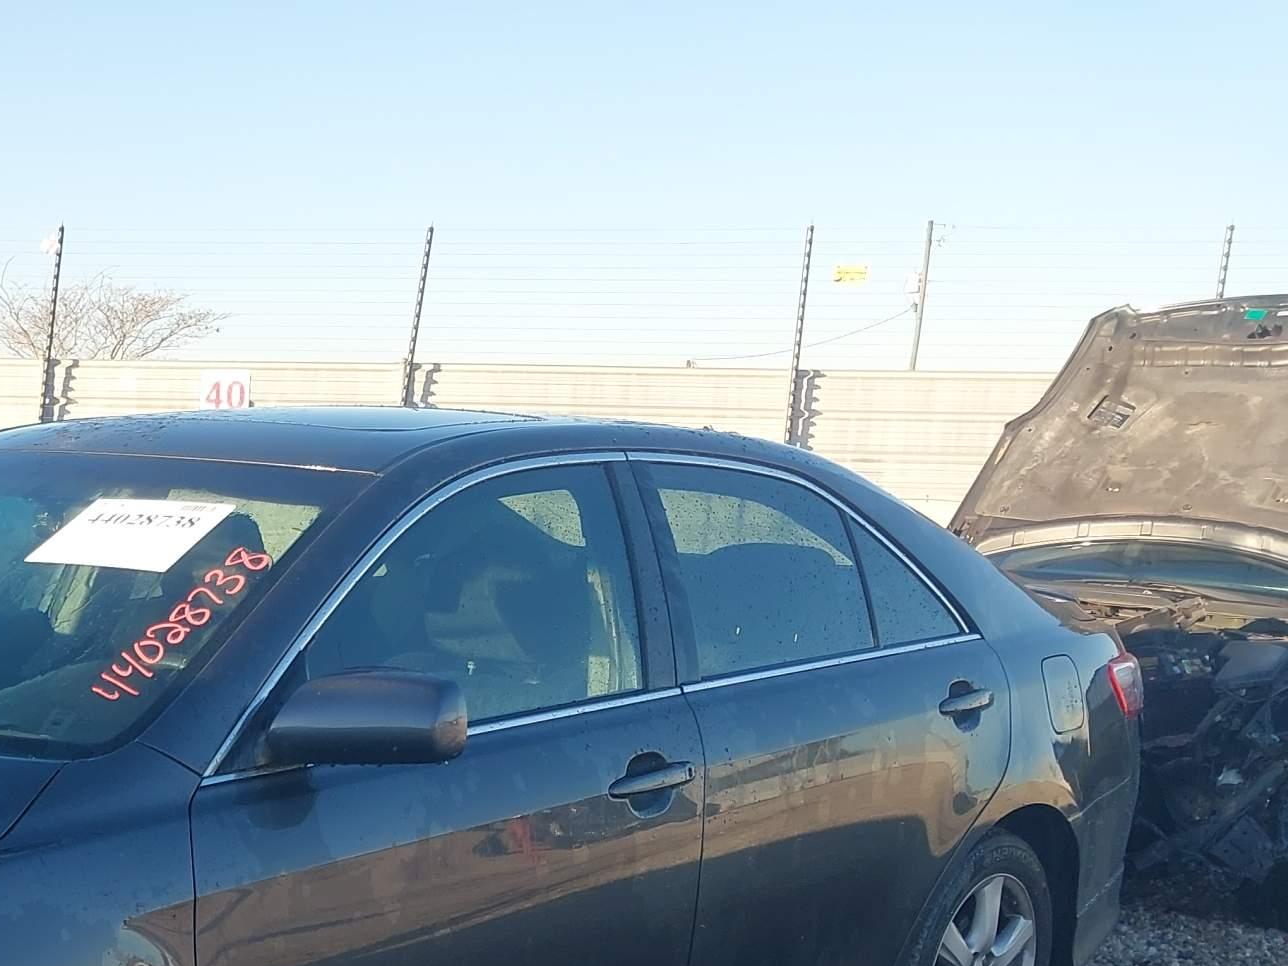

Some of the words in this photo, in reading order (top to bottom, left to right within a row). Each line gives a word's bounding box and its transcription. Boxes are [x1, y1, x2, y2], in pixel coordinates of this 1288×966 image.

[206, 380, 245, 409] 40
[88, 513, 201, 528] 44028738
[92, 547, 274, 701] 44028738
